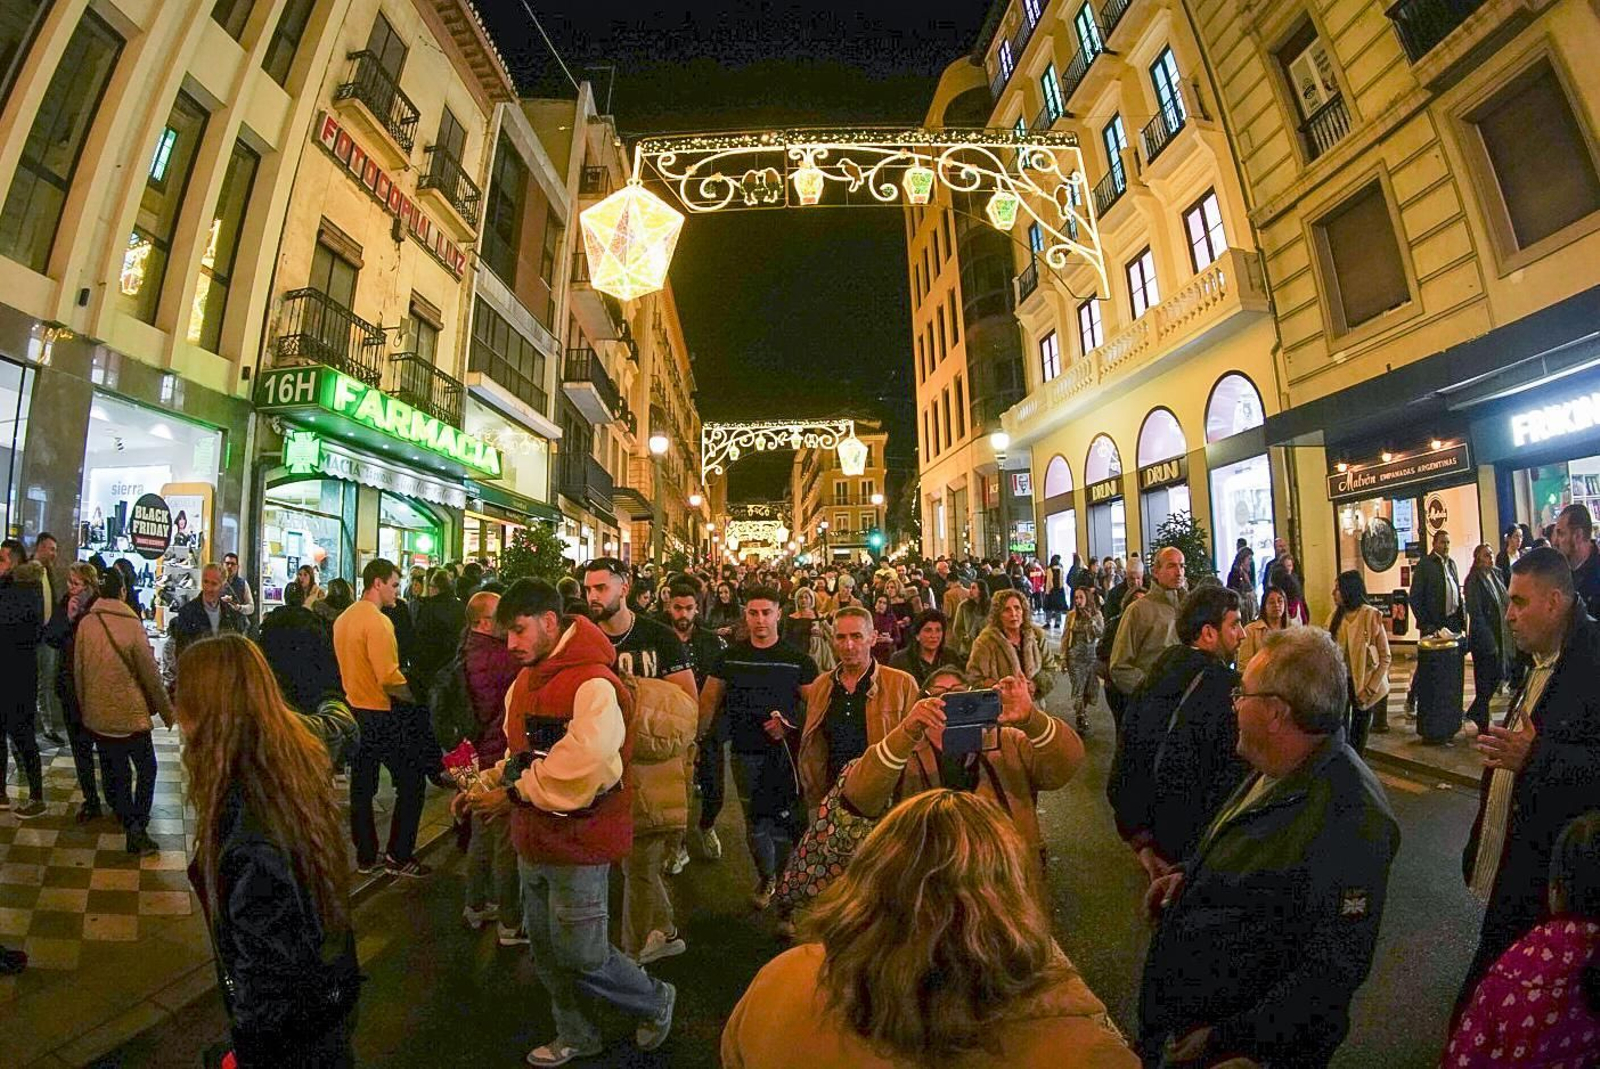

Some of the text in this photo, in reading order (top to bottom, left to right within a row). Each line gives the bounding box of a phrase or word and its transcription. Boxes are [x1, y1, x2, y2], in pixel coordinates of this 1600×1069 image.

[264, 371, 316, 404] 16H
[334, 374, 501, 475] FARMACIA
[1379, 468, 1416, 482] EMPANADAS
[1417, 457, 1457, 473] ARGENTINAS
[111, 481, 144, 496] sierra
[135, 505, 169, 523] BLACK
[132, 520, 170, 538] FRIDAY
